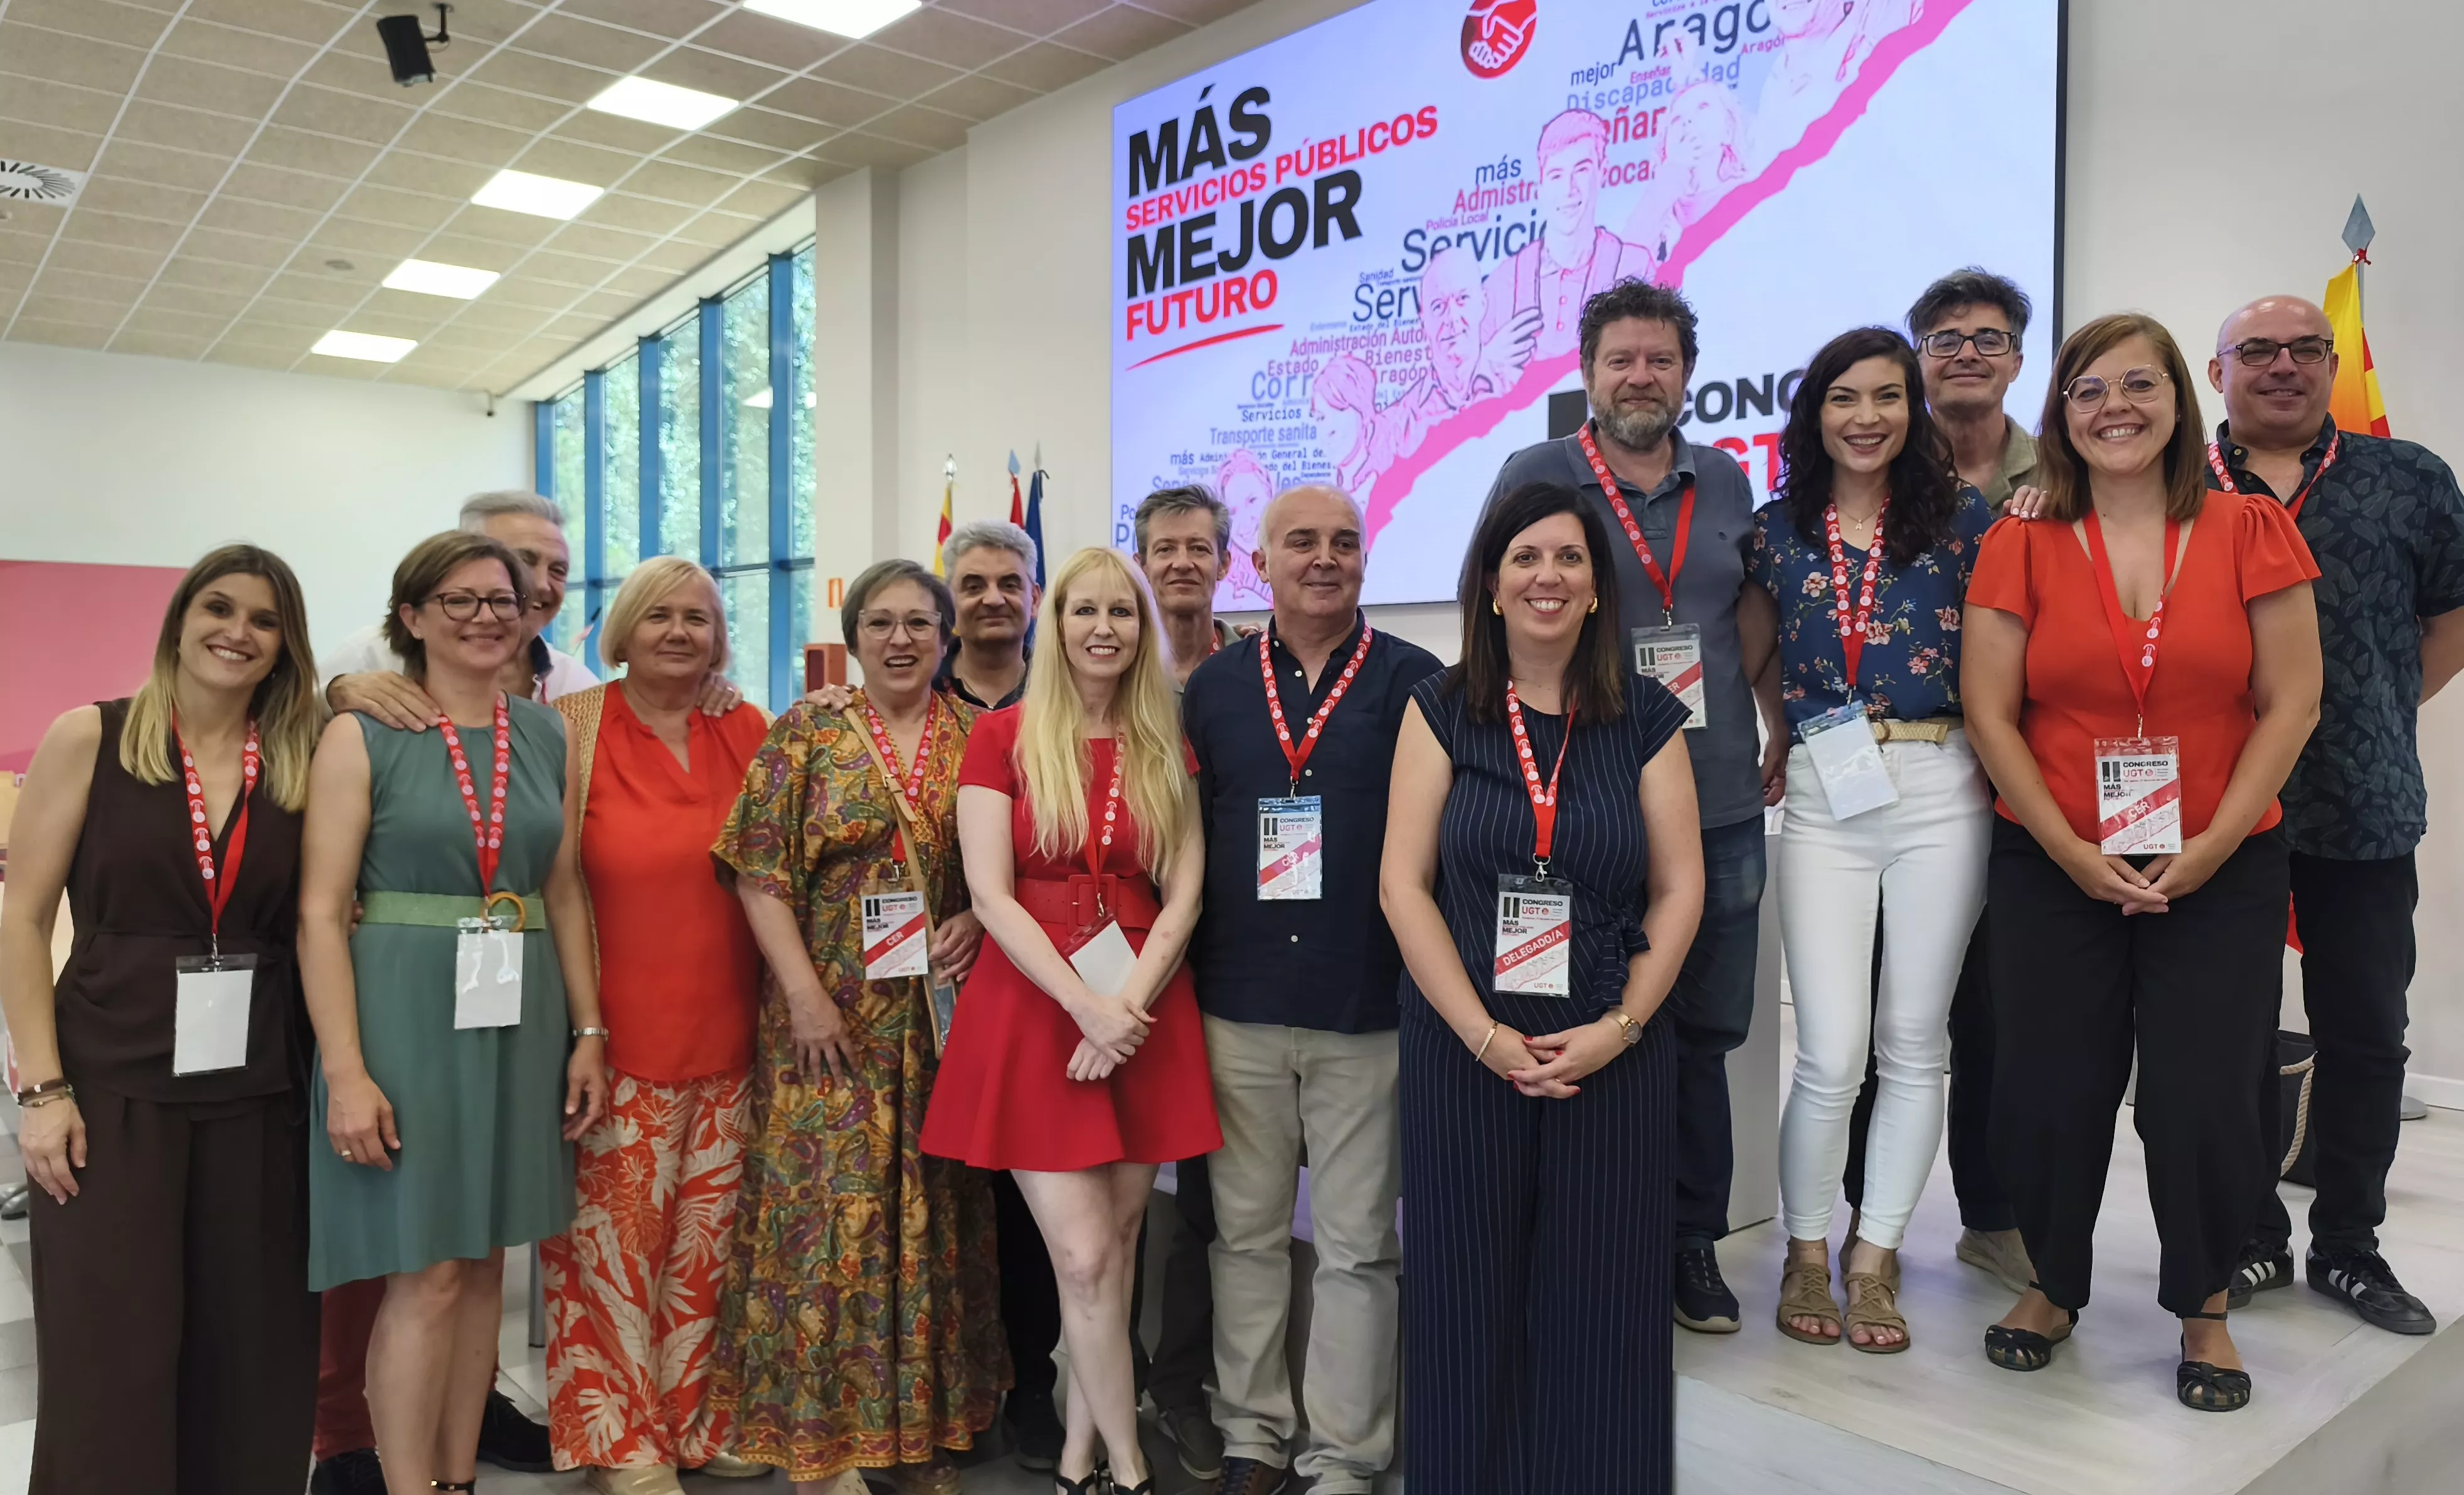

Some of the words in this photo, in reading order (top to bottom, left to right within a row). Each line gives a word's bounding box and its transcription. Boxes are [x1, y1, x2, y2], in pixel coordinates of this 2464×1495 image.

[1571, 61, 1617, 87] mejor
[1129, 83, 1271, 199] MÁS
[1126, 162, 1267, 232] SERVICIOS
[1275, 105, 1438, 184] PÚBLICOS
[1475, 154, 1521, 185] más
[1127, 169, 1362, 300] MEJOR
[1127, 268, 1278, 341] FUTURO
[1290, 328, 1387, 357] Administración
[1268, 356, 1319, 377] Estado
[1242, 408, 1302, 423] Servicios
[1210, 426, 1275, 447] Transporte
[1170, 449, 1194, 465] más
[1657, 653, 1674, 662] UGT
[2123, 769, 2143, 778] UGT
[1521, 906, 1541, 915] UGT
[1522, 899, 1564, 907] CONGRESO
[886, 931, 905, 946] CER
[1502, 929, 1564, 966] DELEGADO/A
